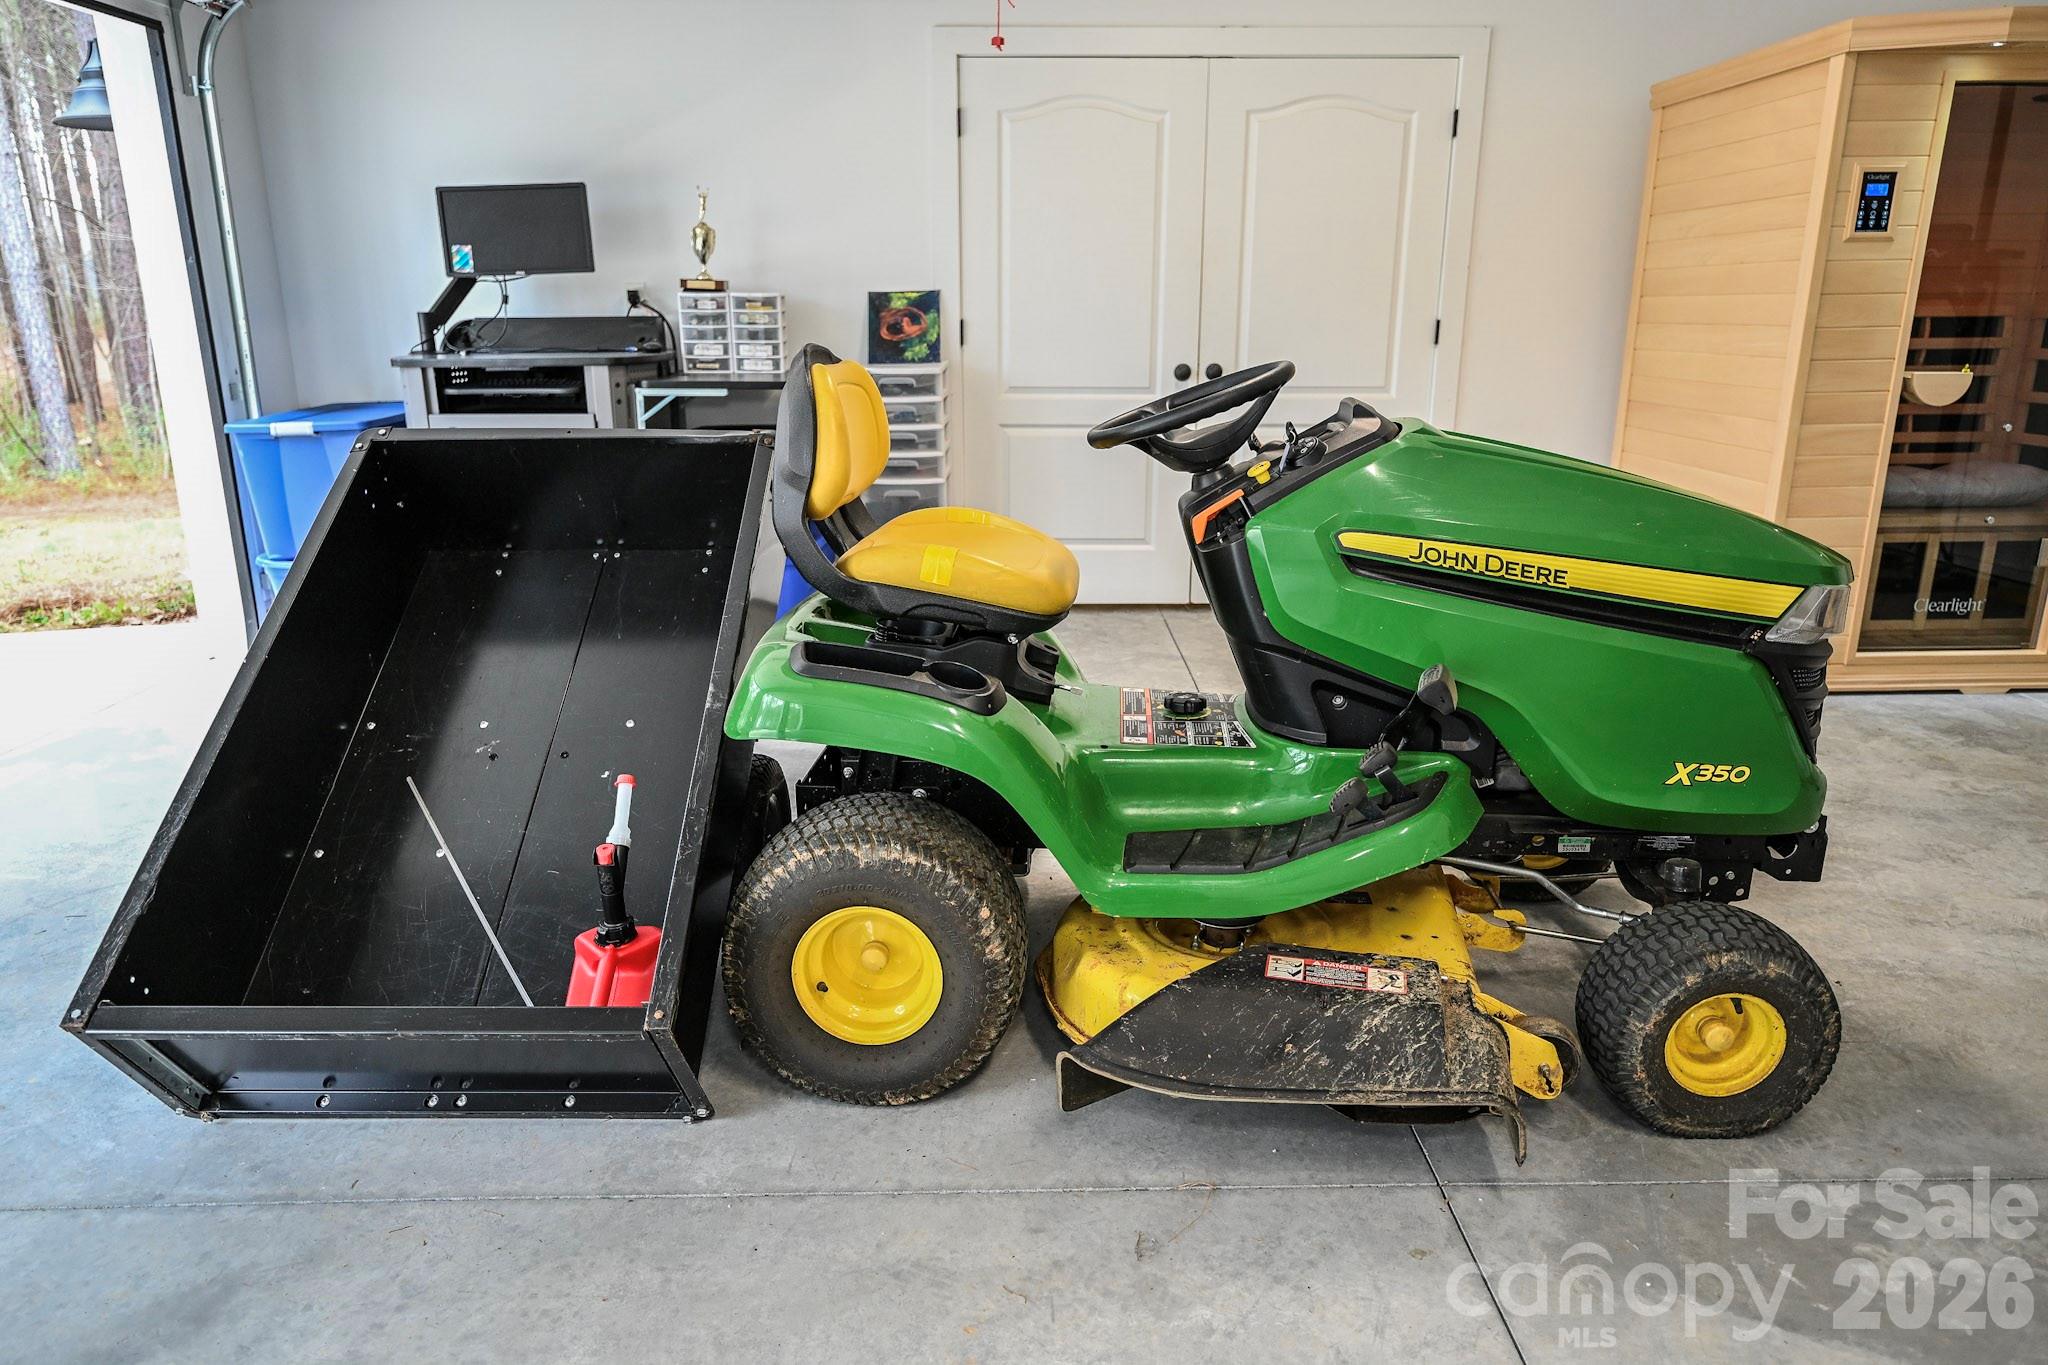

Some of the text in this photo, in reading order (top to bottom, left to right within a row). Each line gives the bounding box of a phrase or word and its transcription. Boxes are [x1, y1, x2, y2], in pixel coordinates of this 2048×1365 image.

[1409, 542, 1568, 585] JOHN DEERE
[1913, 598, 1983, 615] Clearlight
[1664, 762, 1751, 785] X350
[1323, 961, 1362, 971] DANGER
